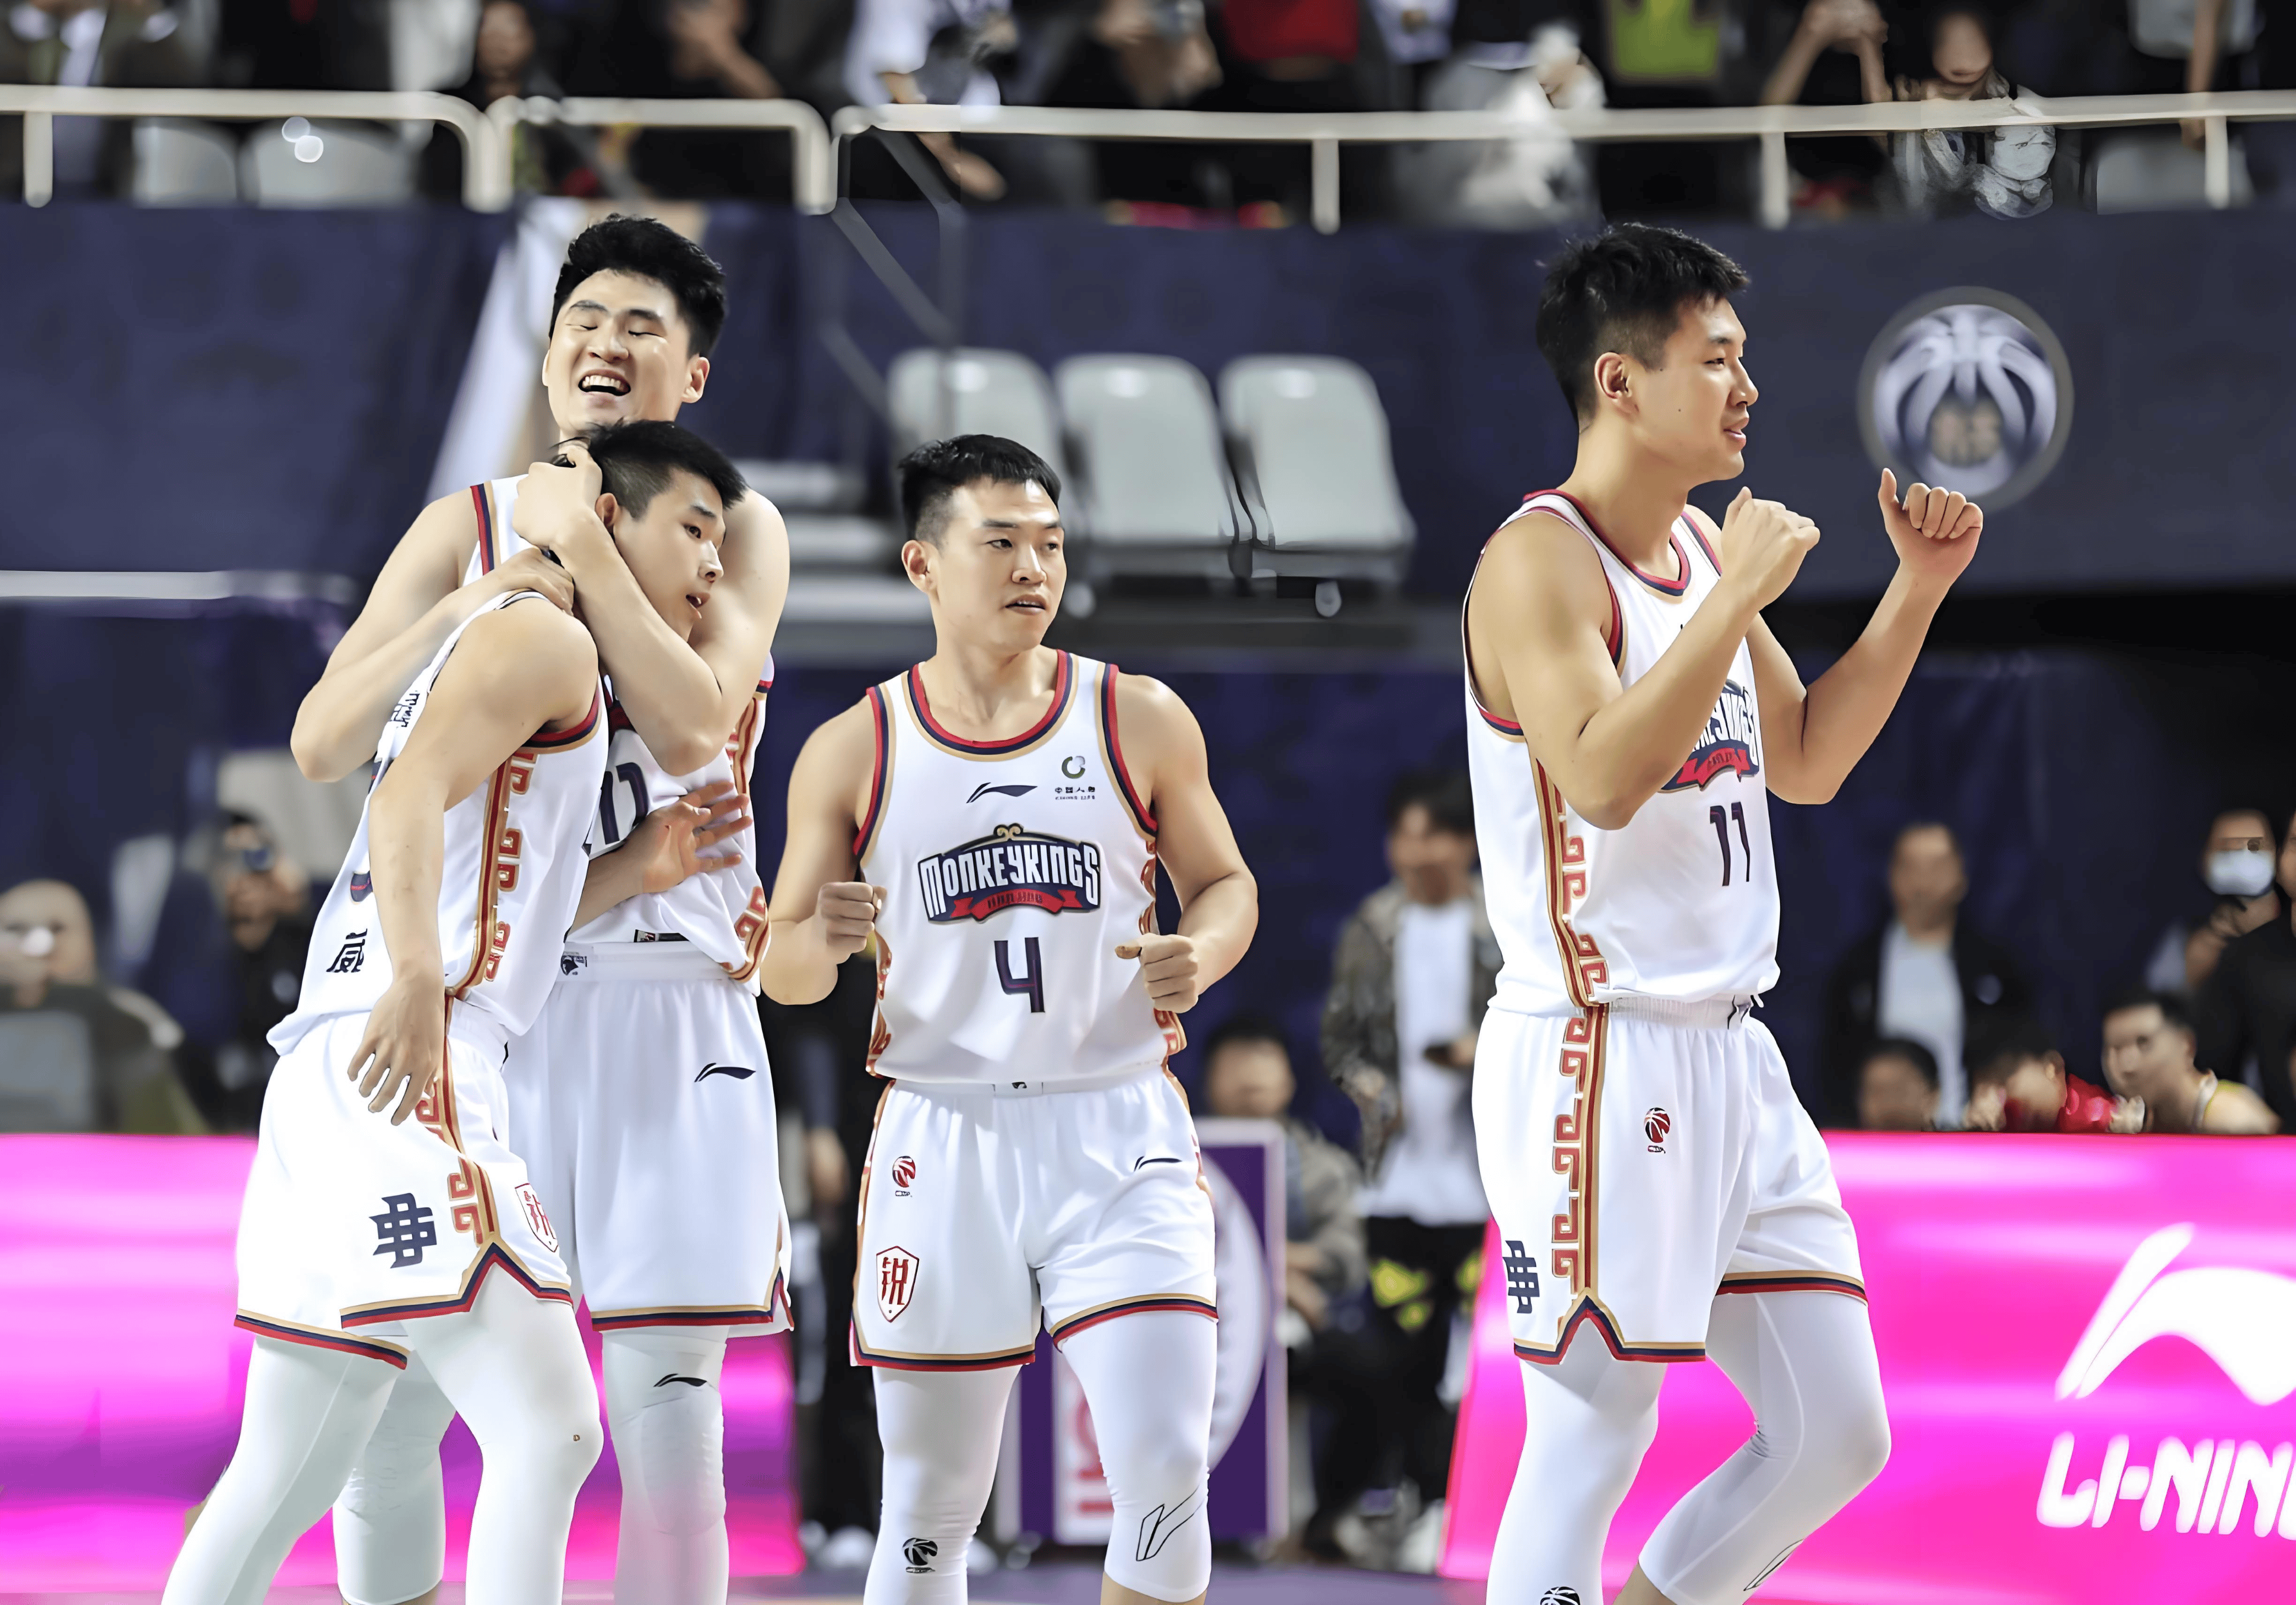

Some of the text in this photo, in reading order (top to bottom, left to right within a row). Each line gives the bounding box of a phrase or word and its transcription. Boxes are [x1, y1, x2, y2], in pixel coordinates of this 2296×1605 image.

[920, 844, 1099, 918] MONKEYKINGS
[1710, 802, 1750, 886] 11
[994, 937, 1045, 1013] 4
